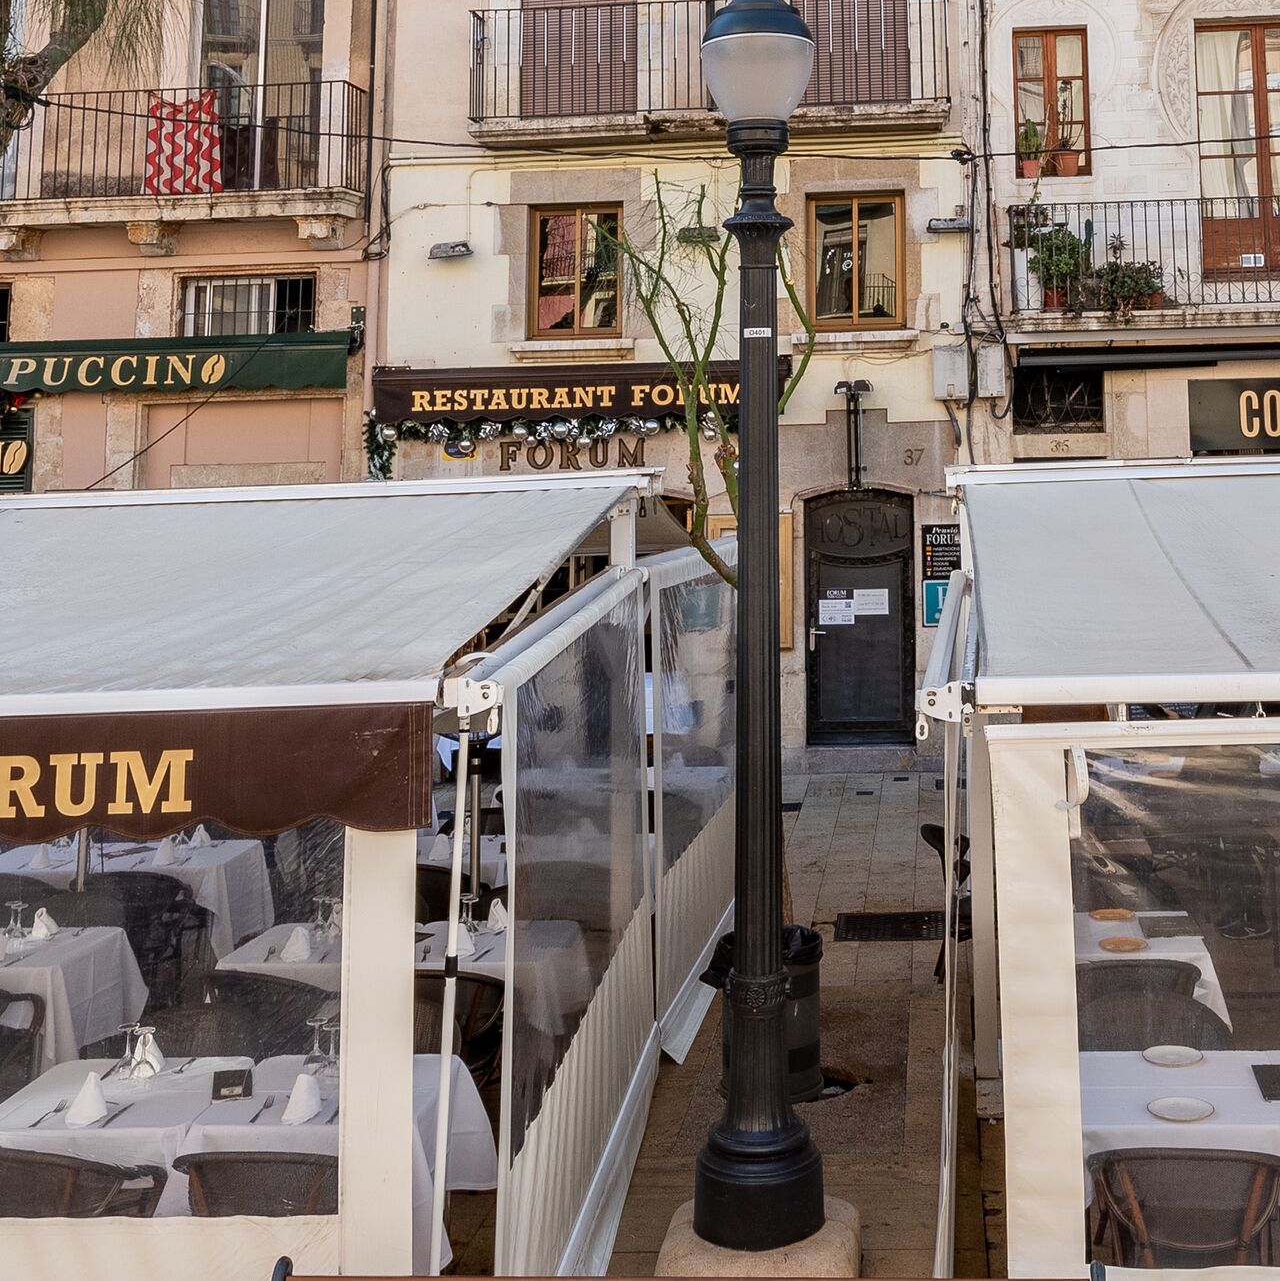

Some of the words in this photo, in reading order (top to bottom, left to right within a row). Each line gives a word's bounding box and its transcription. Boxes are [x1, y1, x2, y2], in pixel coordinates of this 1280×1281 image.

[411, 385, 616, 412] RESTAURANT
[499, 438, 646, 471] FORUM
[1050, 439, 1070, 453] 35
[903, 449, 925, 466] 37
